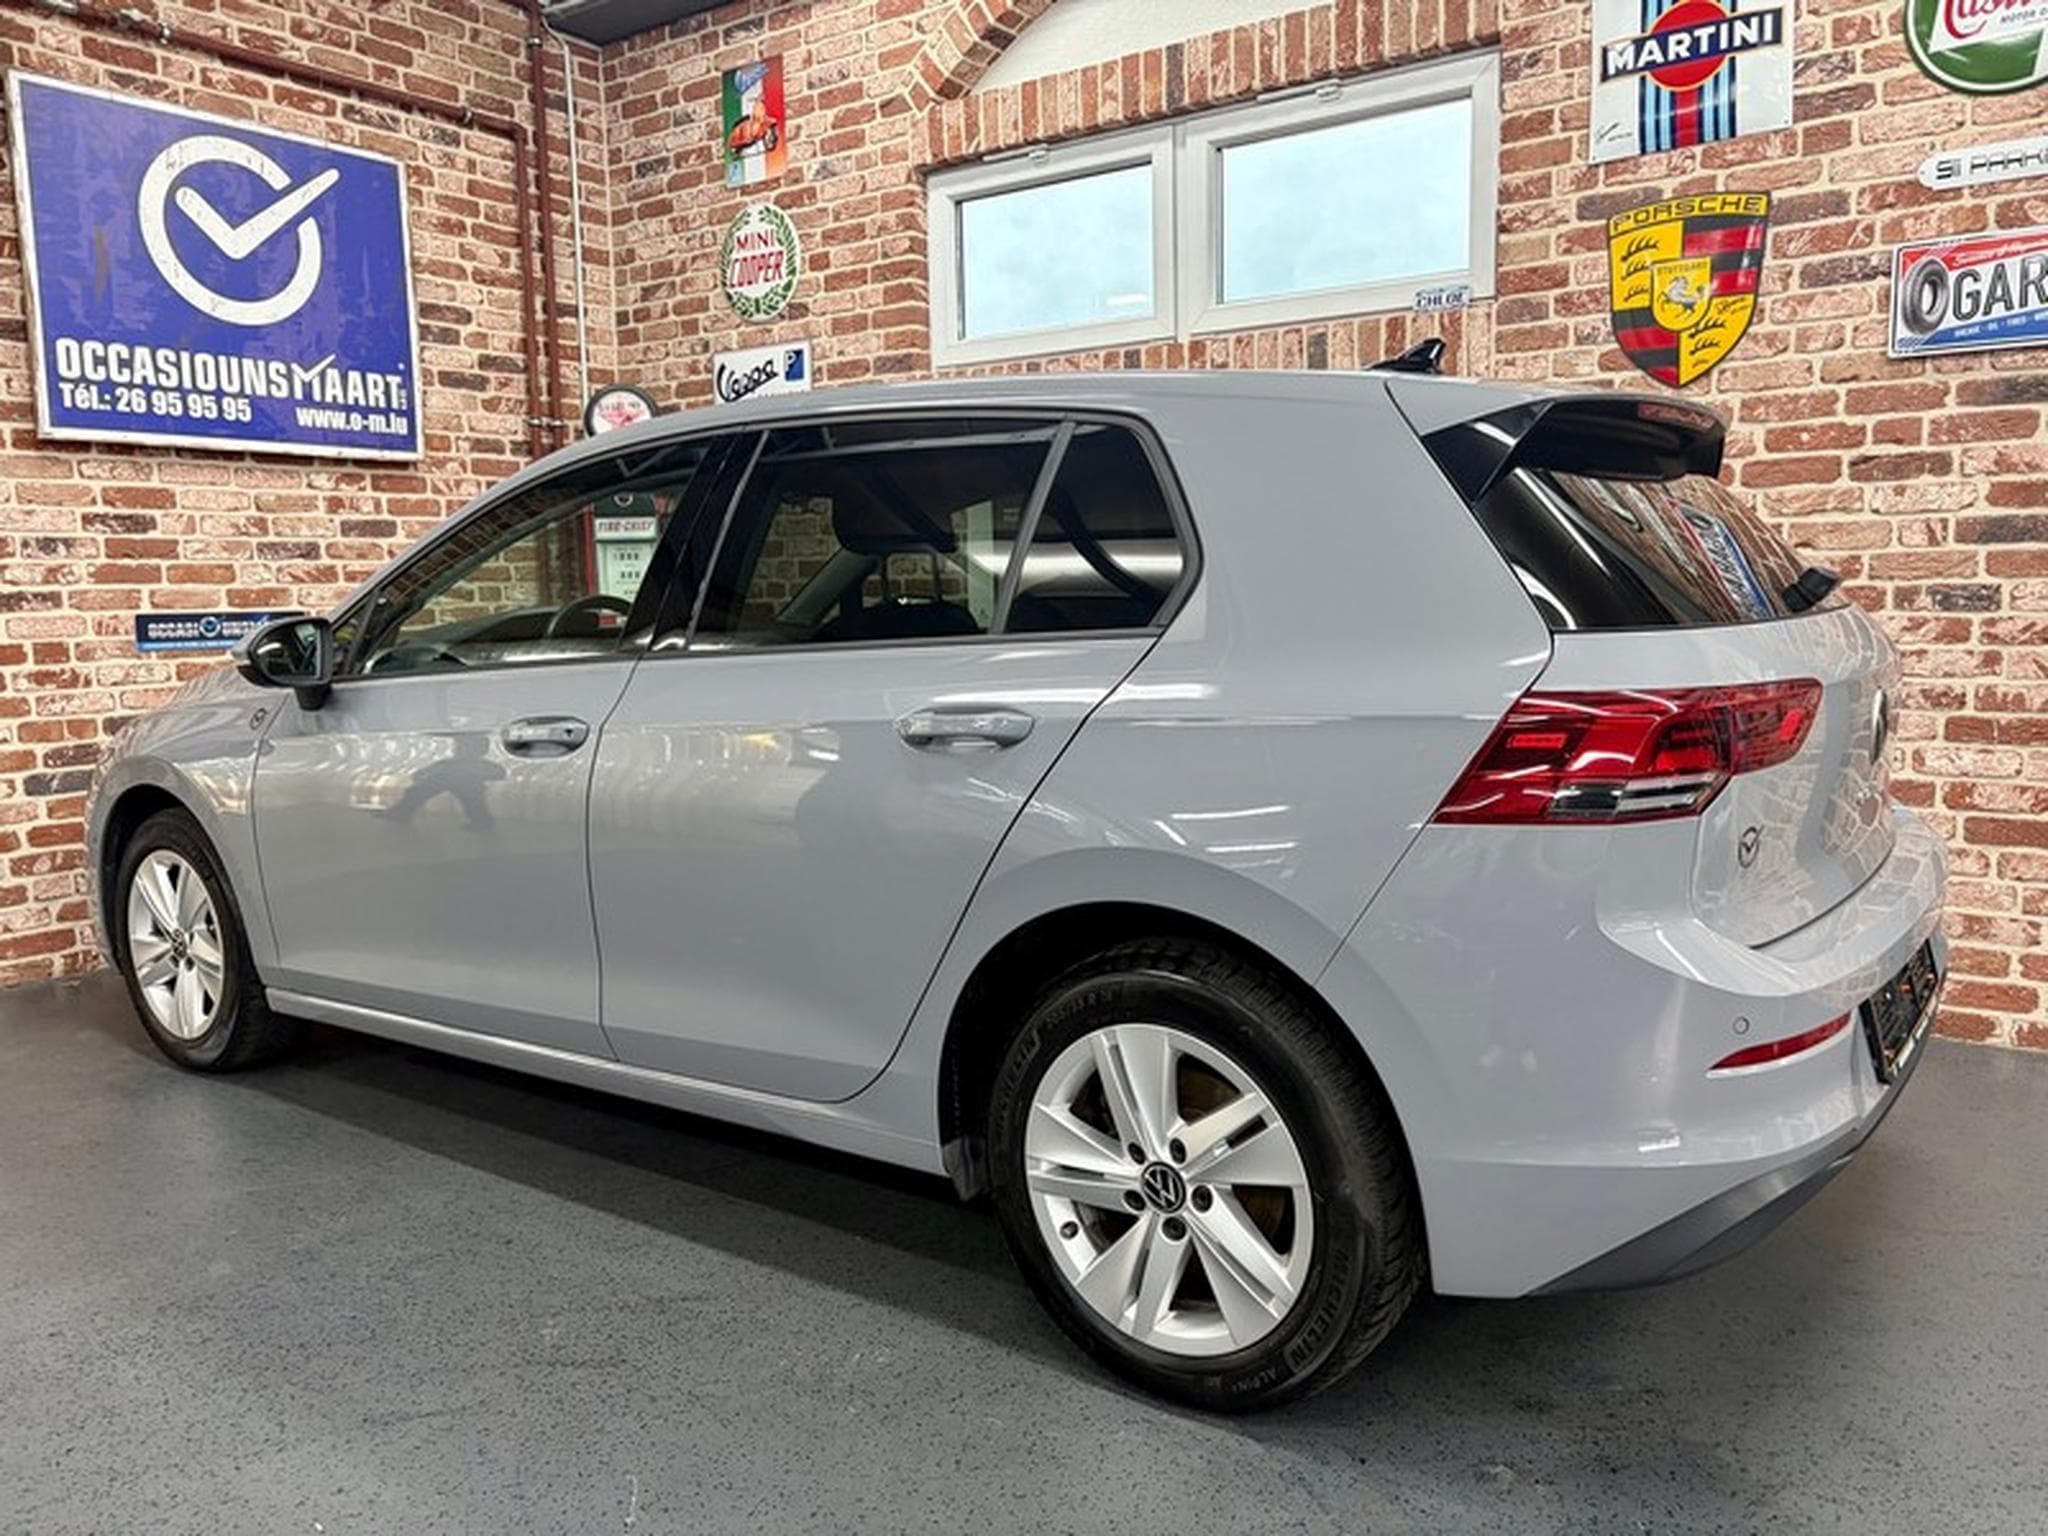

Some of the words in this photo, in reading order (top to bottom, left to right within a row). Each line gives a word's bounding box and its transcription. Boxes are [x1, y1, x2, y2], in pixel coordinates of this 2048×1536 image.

[1607, 13, 1773, 76] MARTINI
[1613, 196, 1762, 232] PORSCHE
[735, 227, 776, 253] MINI
[729, 249, 784, 289] COOPER
[55, 336, 402, 410] OCCASIOUNSMAART
[717, 361, 779, 403] Vespa
[58, 382, 110, 411] Tél.:
[114, 386, 147, 414] 26
[151, 390, 183, 416] 95
[190, 393, 219, 420] 95
[221, 396, 252, 423] 95
[295, 406, 409, 436] www.o-m.lu
